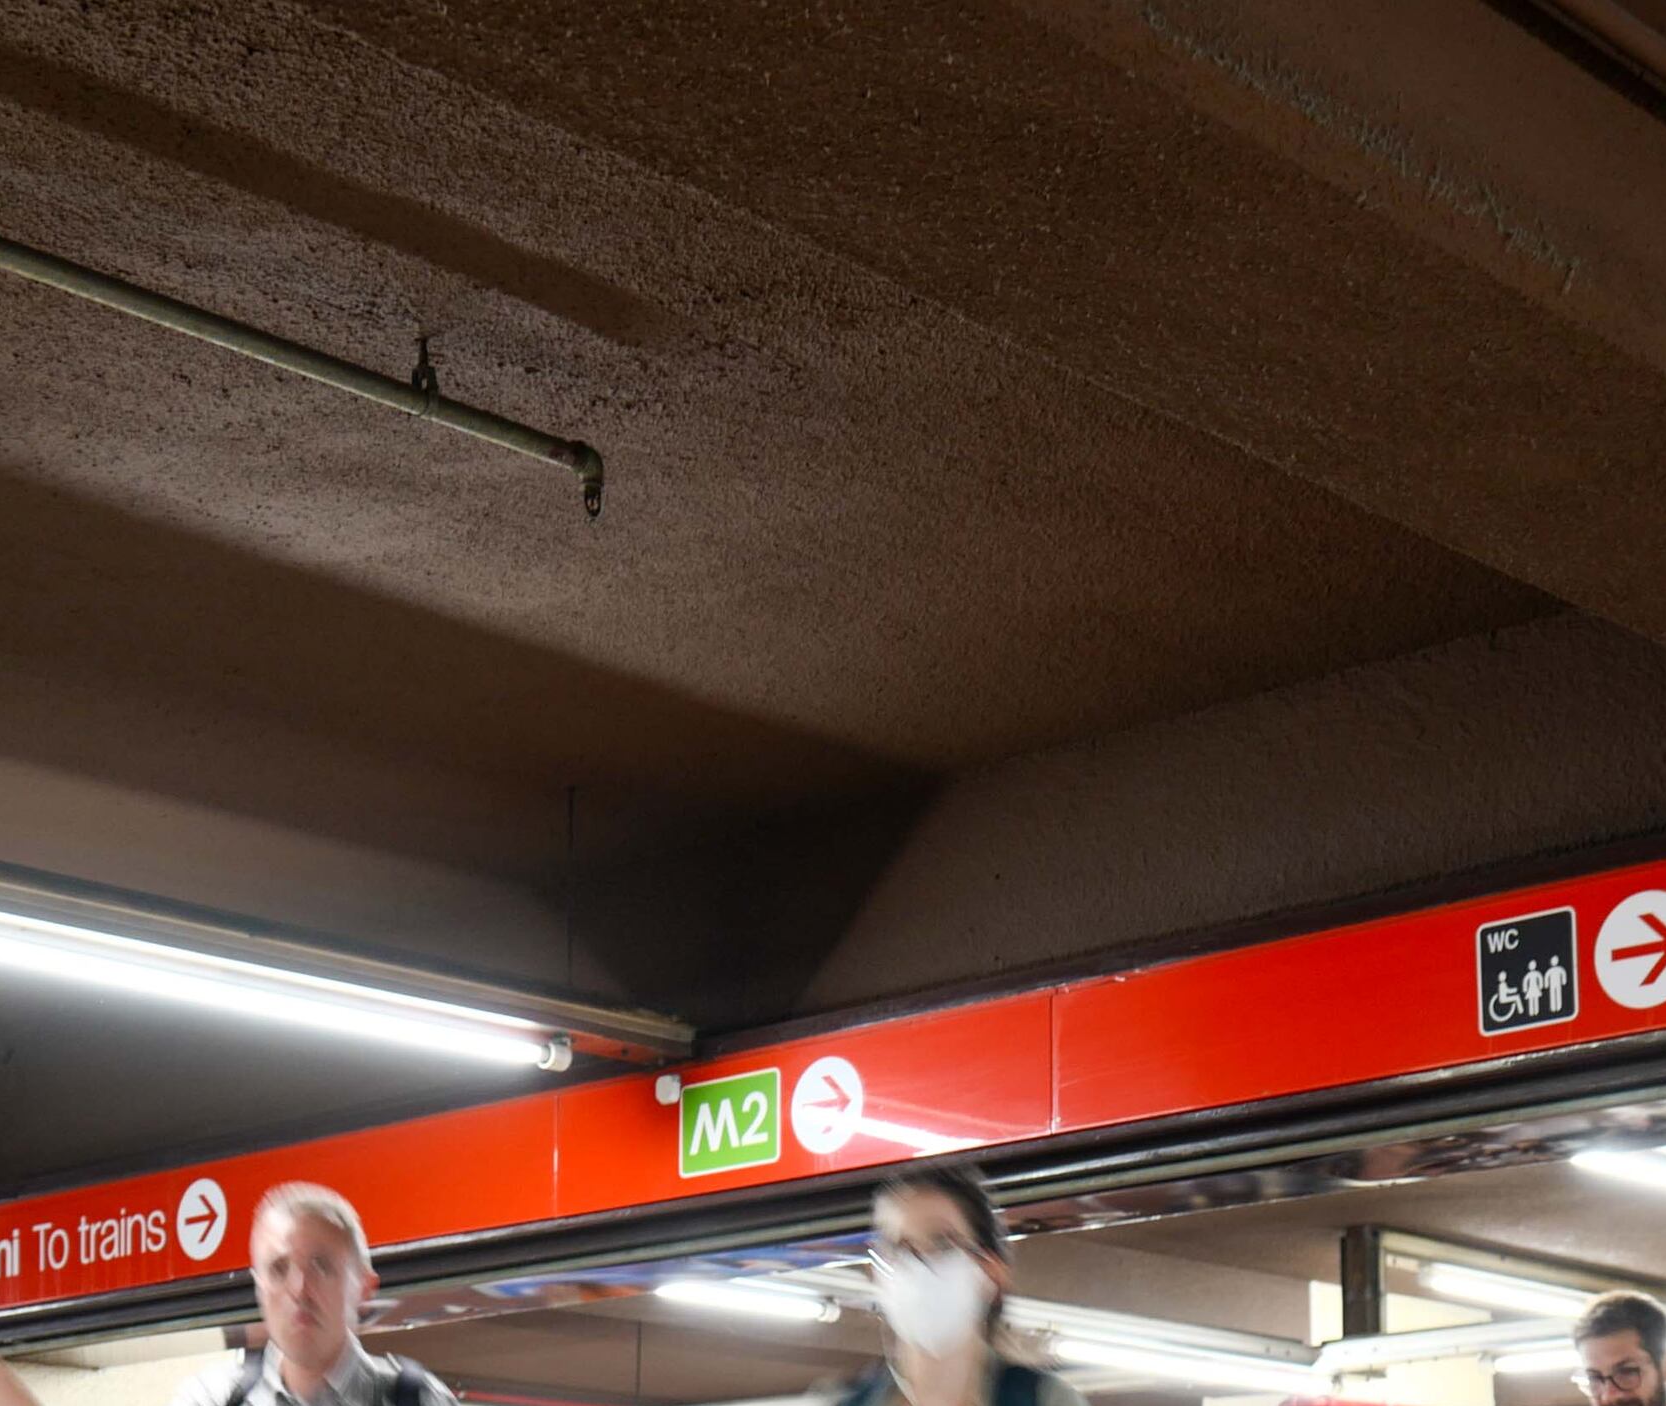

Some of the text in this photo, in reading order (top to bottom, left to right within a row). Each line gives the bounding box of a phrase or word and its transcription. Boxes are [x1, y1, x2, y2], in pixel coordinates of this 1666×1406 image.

[1487, 928, 1520, 953] WC
[689, 1091, 769, 1156] M2
[32, 1223, 70, 1272] To
[78, 1208, 167, 1265] trains
